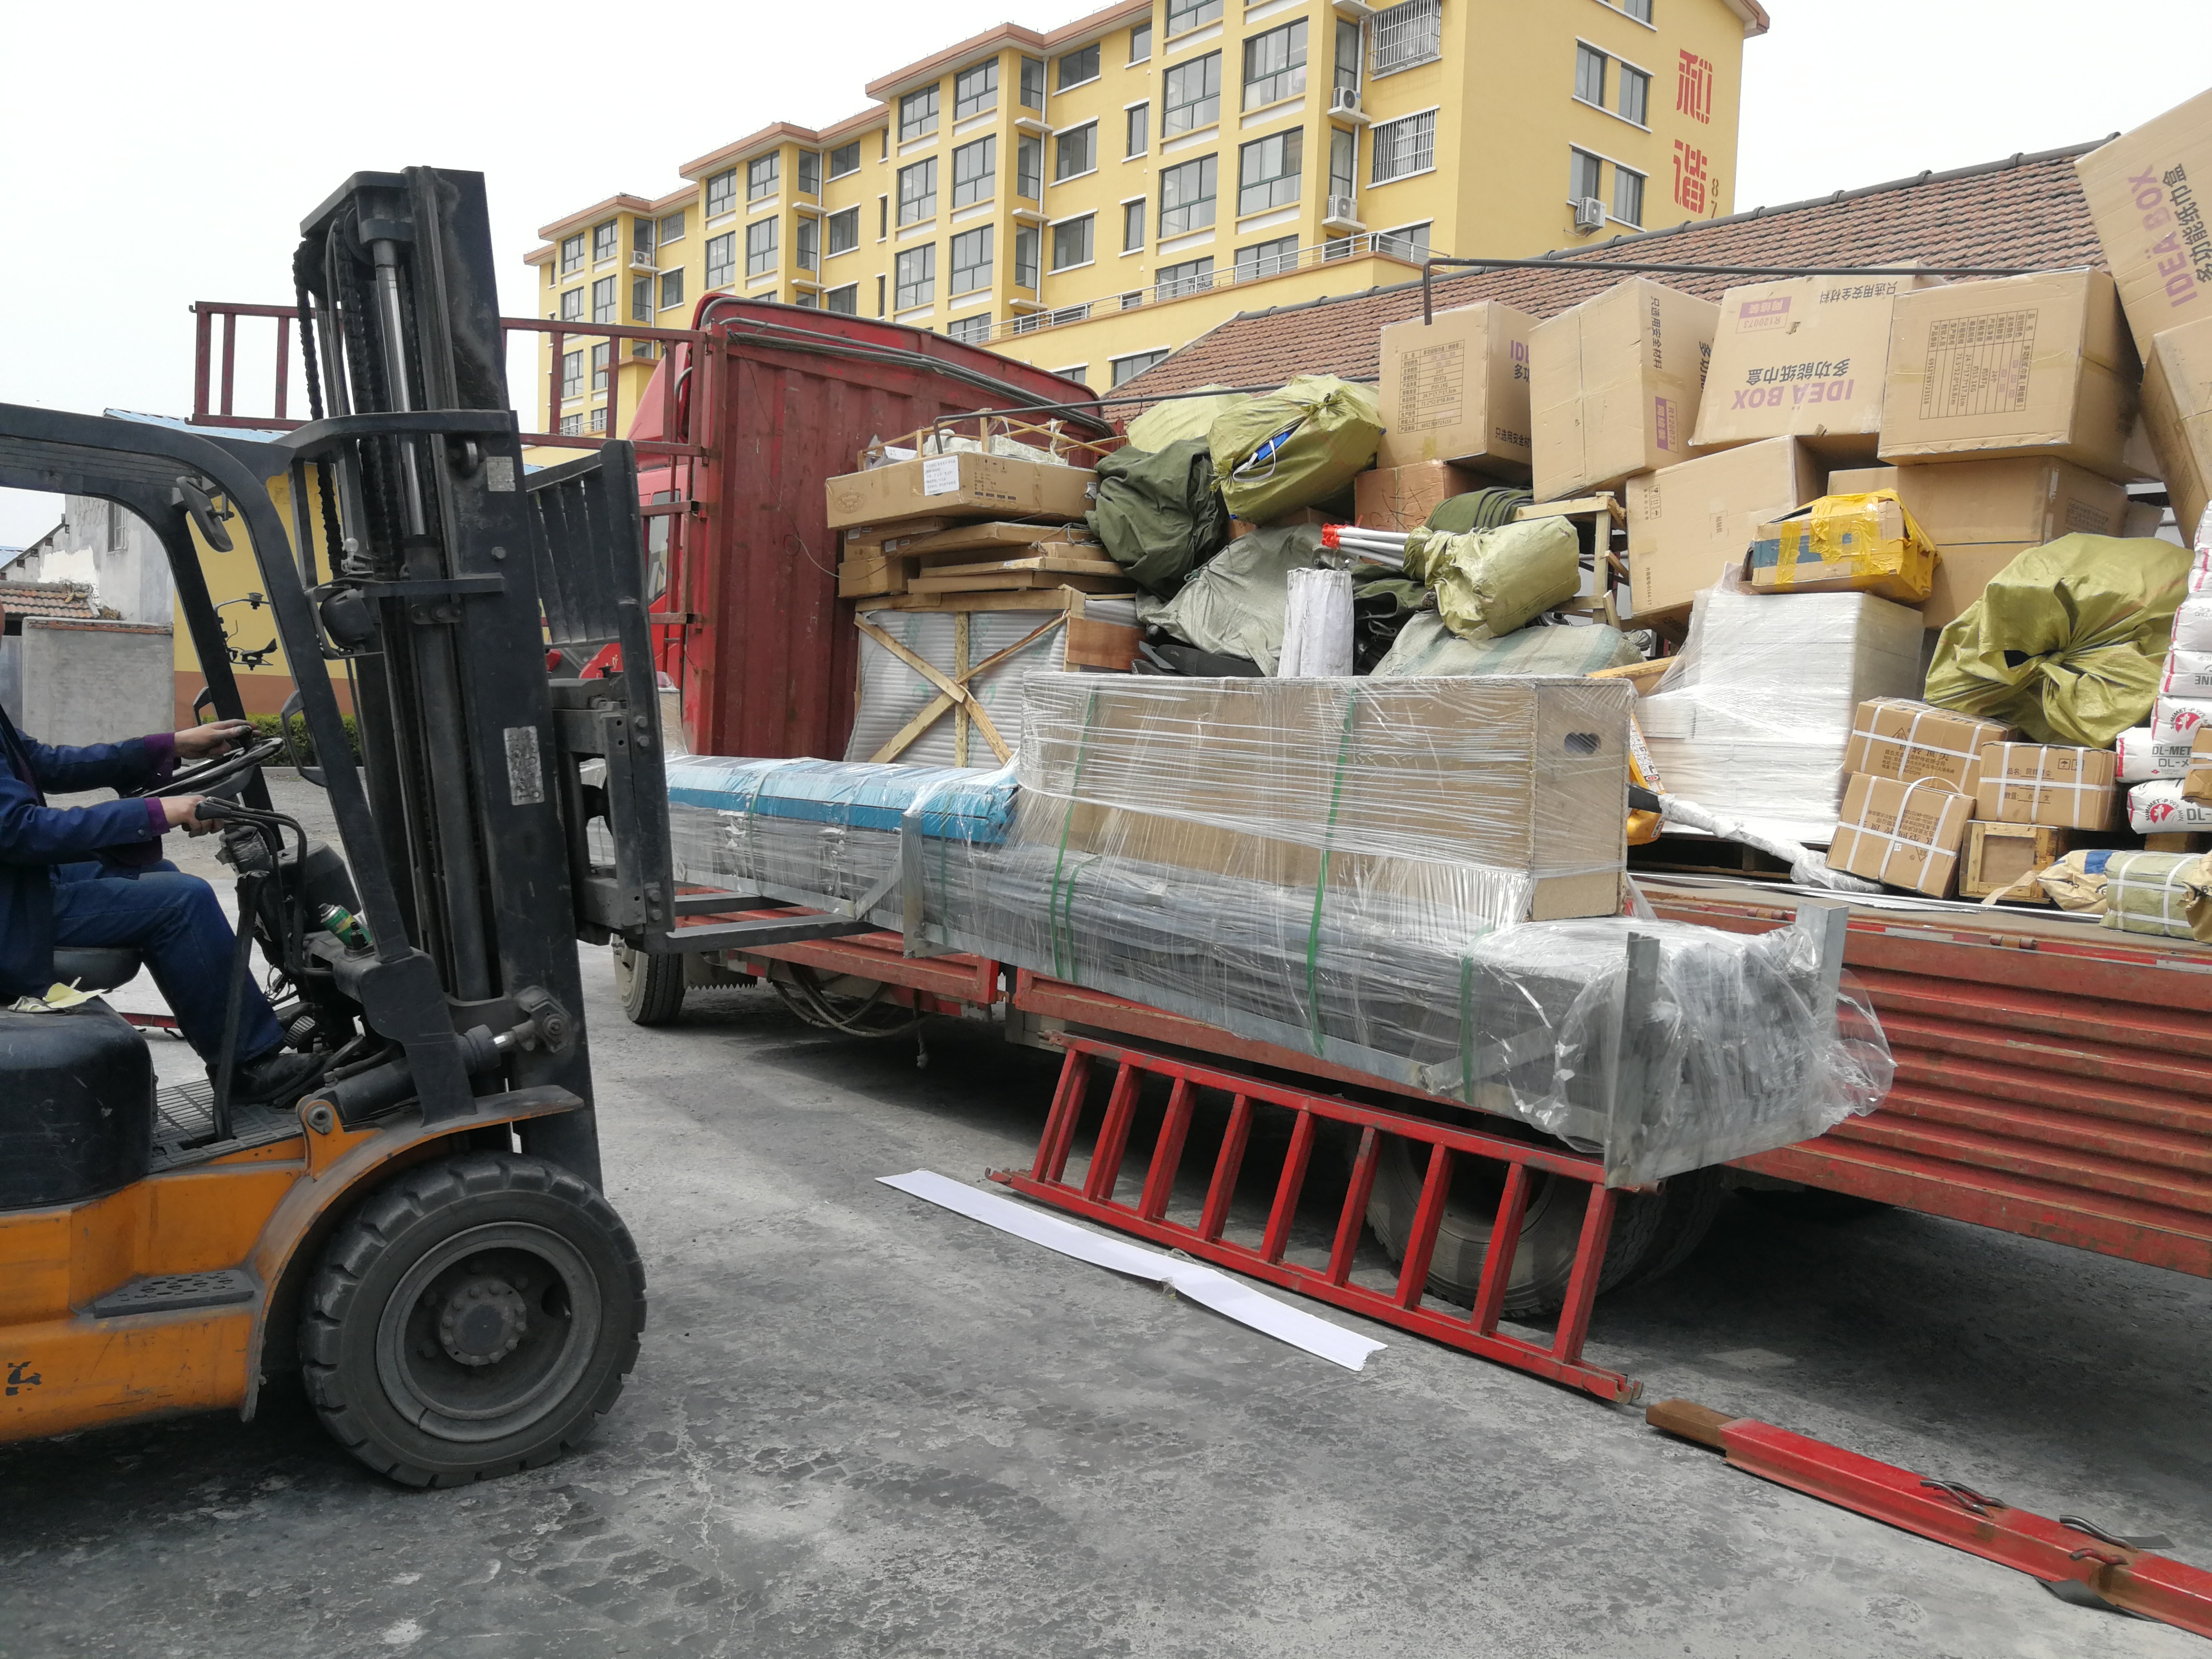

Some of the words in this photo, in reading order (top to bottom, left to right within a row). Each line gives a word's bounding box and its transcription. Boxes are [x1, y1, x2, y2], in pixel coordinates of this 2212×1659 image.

[2128, 164, 2171, 232] BOX
[2162, 163, 2212, 283] 多功能纸巾盒
[1820, 281, 1898, 304] 只选用安全材料
[1651, 296, 1662, 369] 只选用安全材料
[1744, 316, 1781, 329] R120073
[1746, 357, 1850, 386] 多功能纸巾盒
[1730, 386, 1784, 410] BOX
